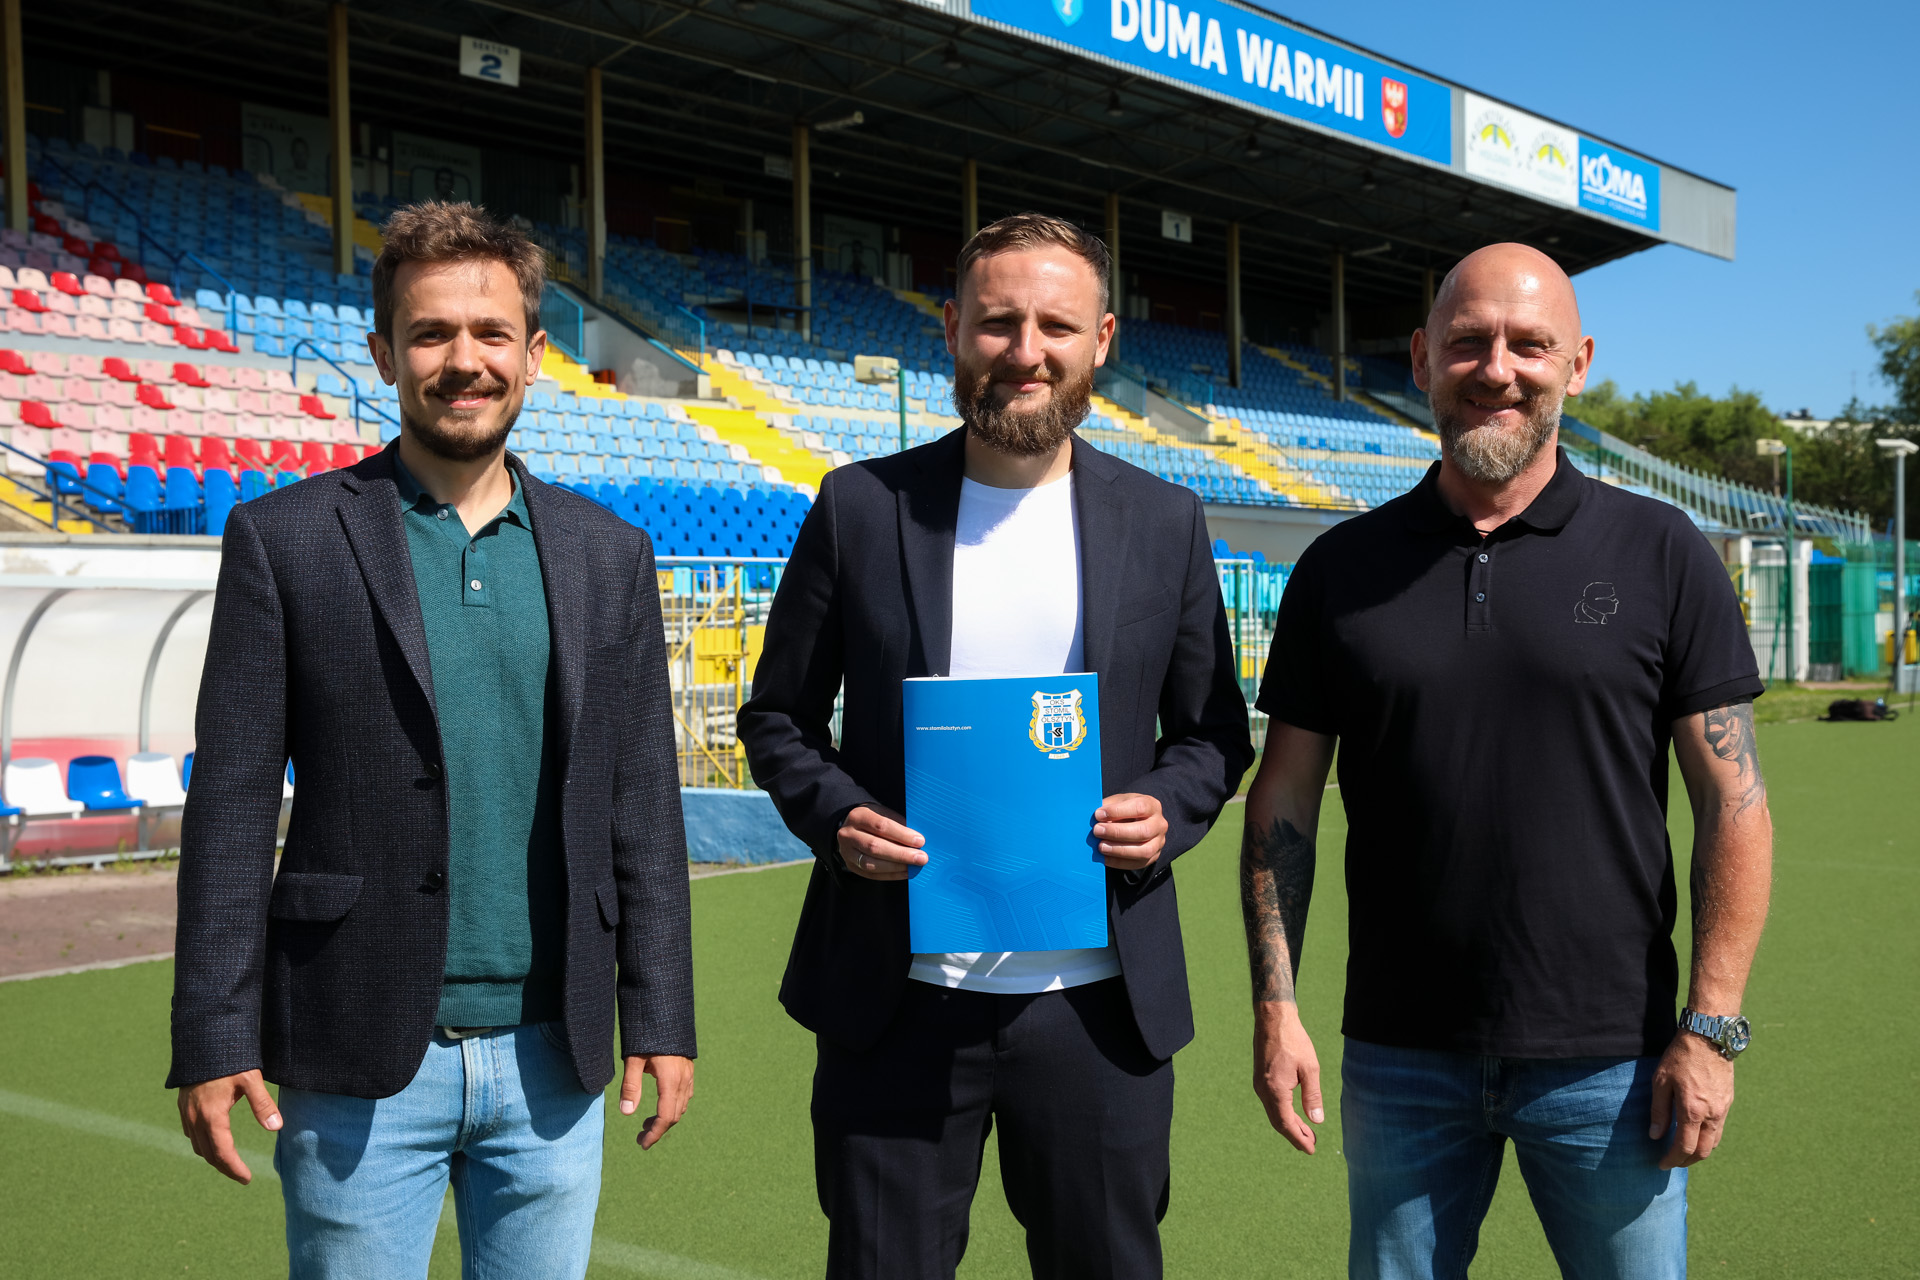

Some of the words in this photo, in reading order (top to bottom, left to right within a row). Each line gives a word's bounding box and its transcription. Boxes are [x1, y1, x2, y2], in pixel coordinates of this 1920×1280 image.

[480, 53, 502, 79] 2
[1110, 0, 1228, 76] DUMA
[1236, 28, 1364, 121] WARMII
[1581, 153, 1647, 204] KOMA
[1174, 223, 1180, 238] 1
[1041, 715, 1075, 723] OLSZTYN
[1045, 707, 1070, 715] STOMIL
